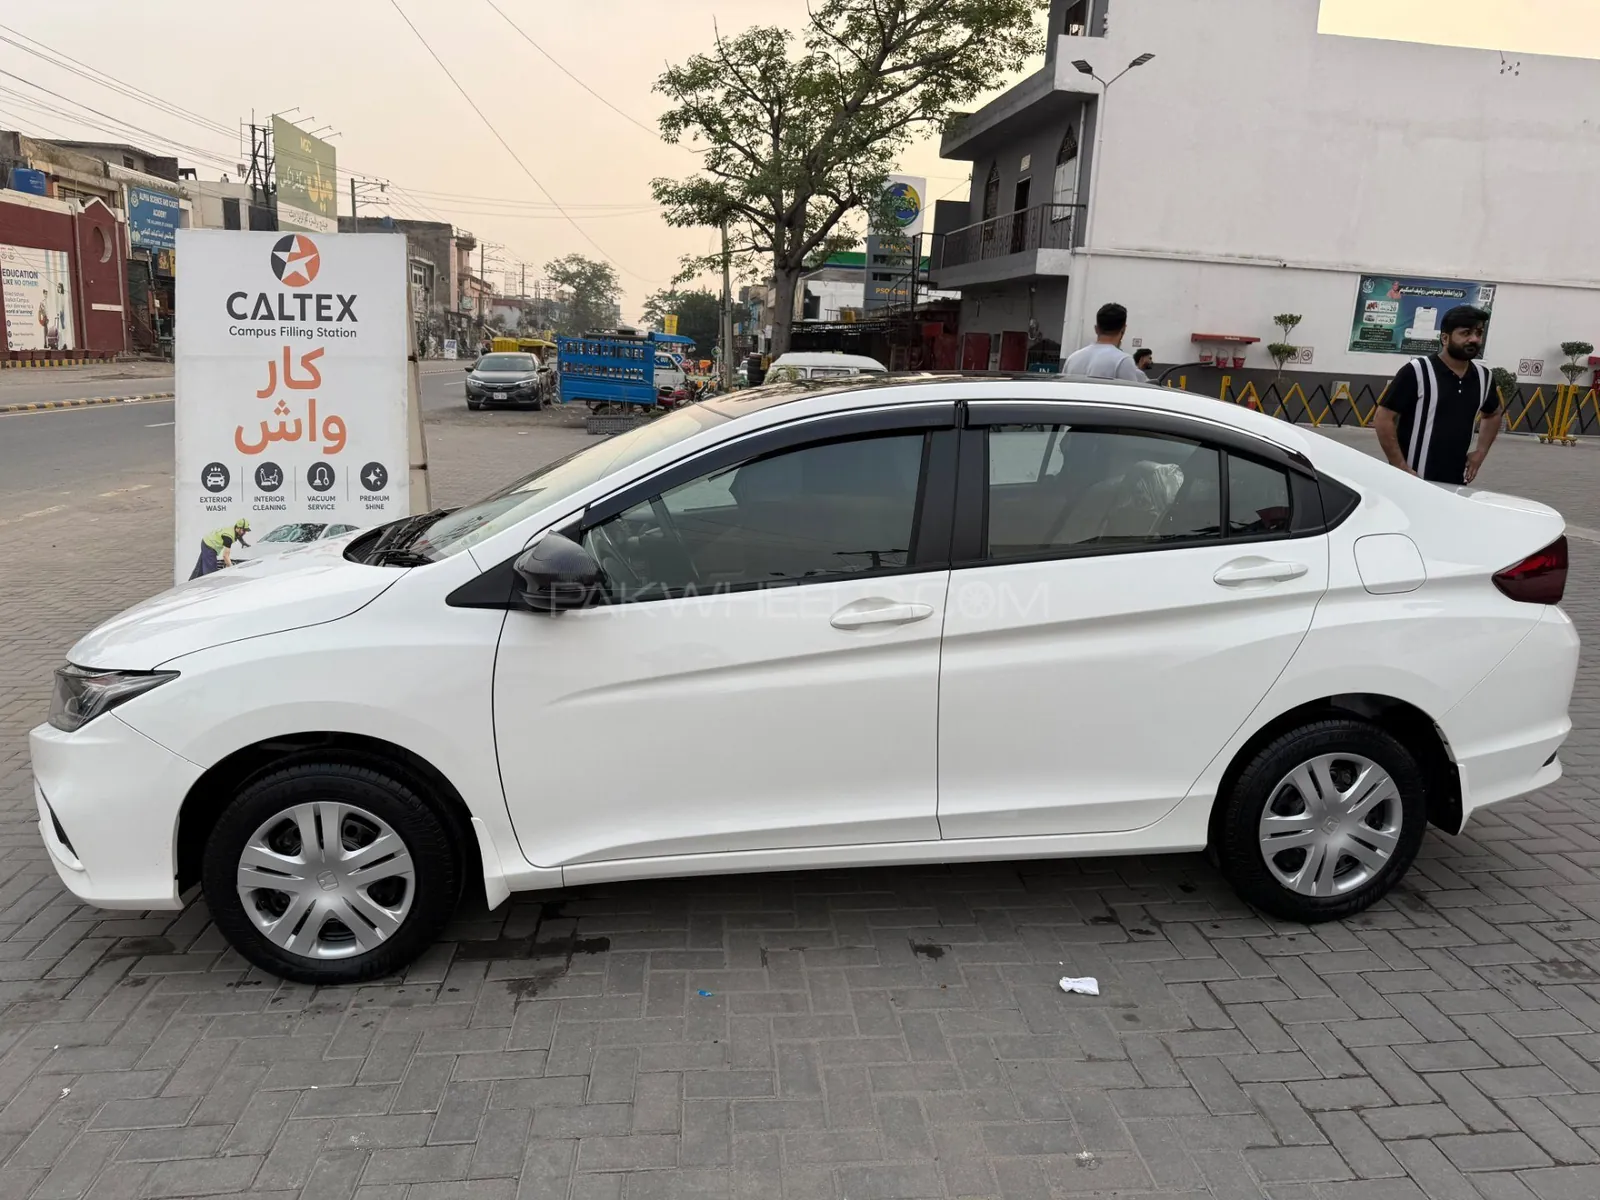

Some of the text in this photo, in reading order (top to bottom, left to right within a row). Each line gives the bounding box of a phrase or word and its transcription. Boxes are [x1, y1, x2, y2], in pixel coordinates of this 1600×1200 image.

[150, 195, 163, 205] SCIENCE
[2, 269, 38, 279] EDUCATION
[226, 291, 358, 322] CALTEX
[229, 325, 357, 340] Campus Filling Station
[256, 346, 325, 399] کار
[234, 398, 347, 455] واش
[307, 503, 335, 511] SERVICE
